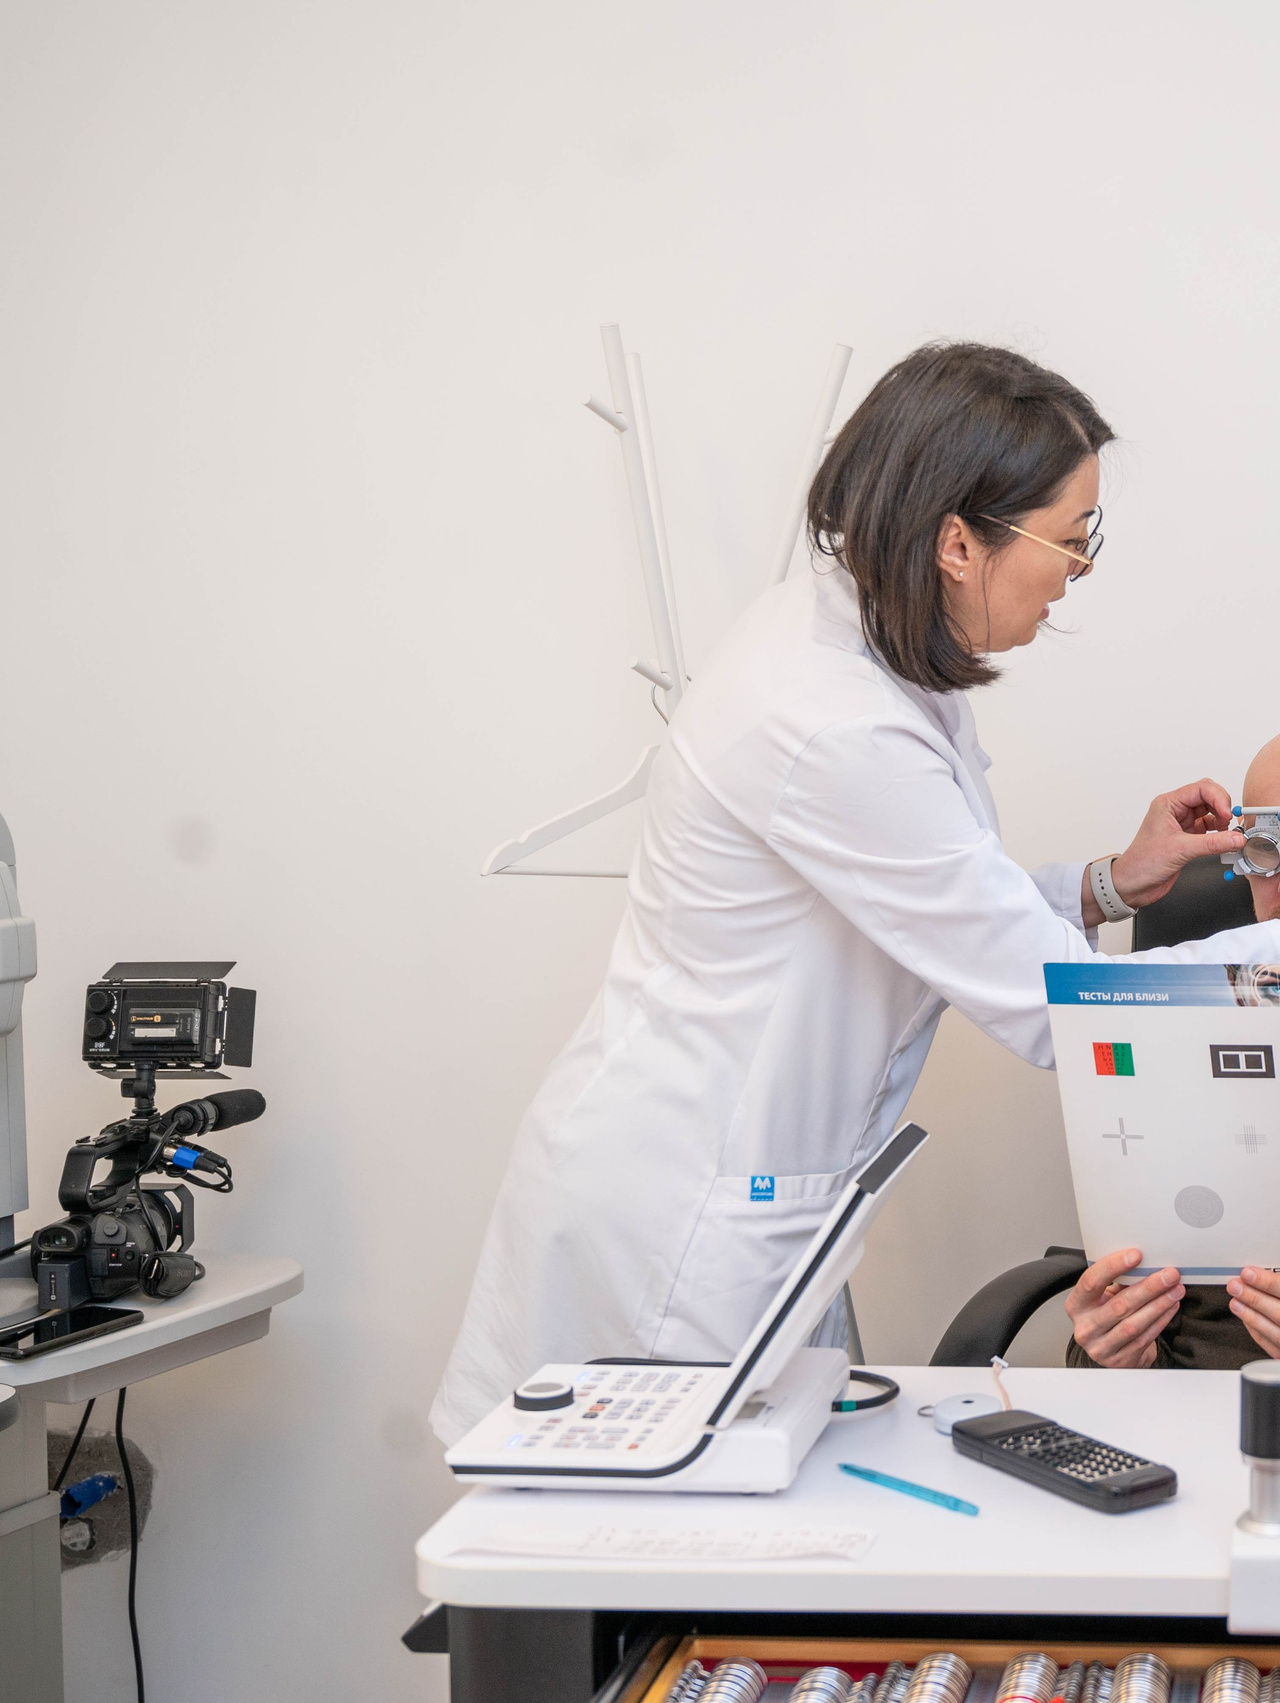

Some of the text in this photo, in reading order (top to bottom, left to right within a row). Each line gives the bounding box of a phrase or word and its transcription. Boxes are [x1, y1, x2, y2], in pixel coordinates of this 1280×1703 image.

[1078, 991, 1169, 1002] ТЕСТЫ ДЛЯ БЛИЗИ
